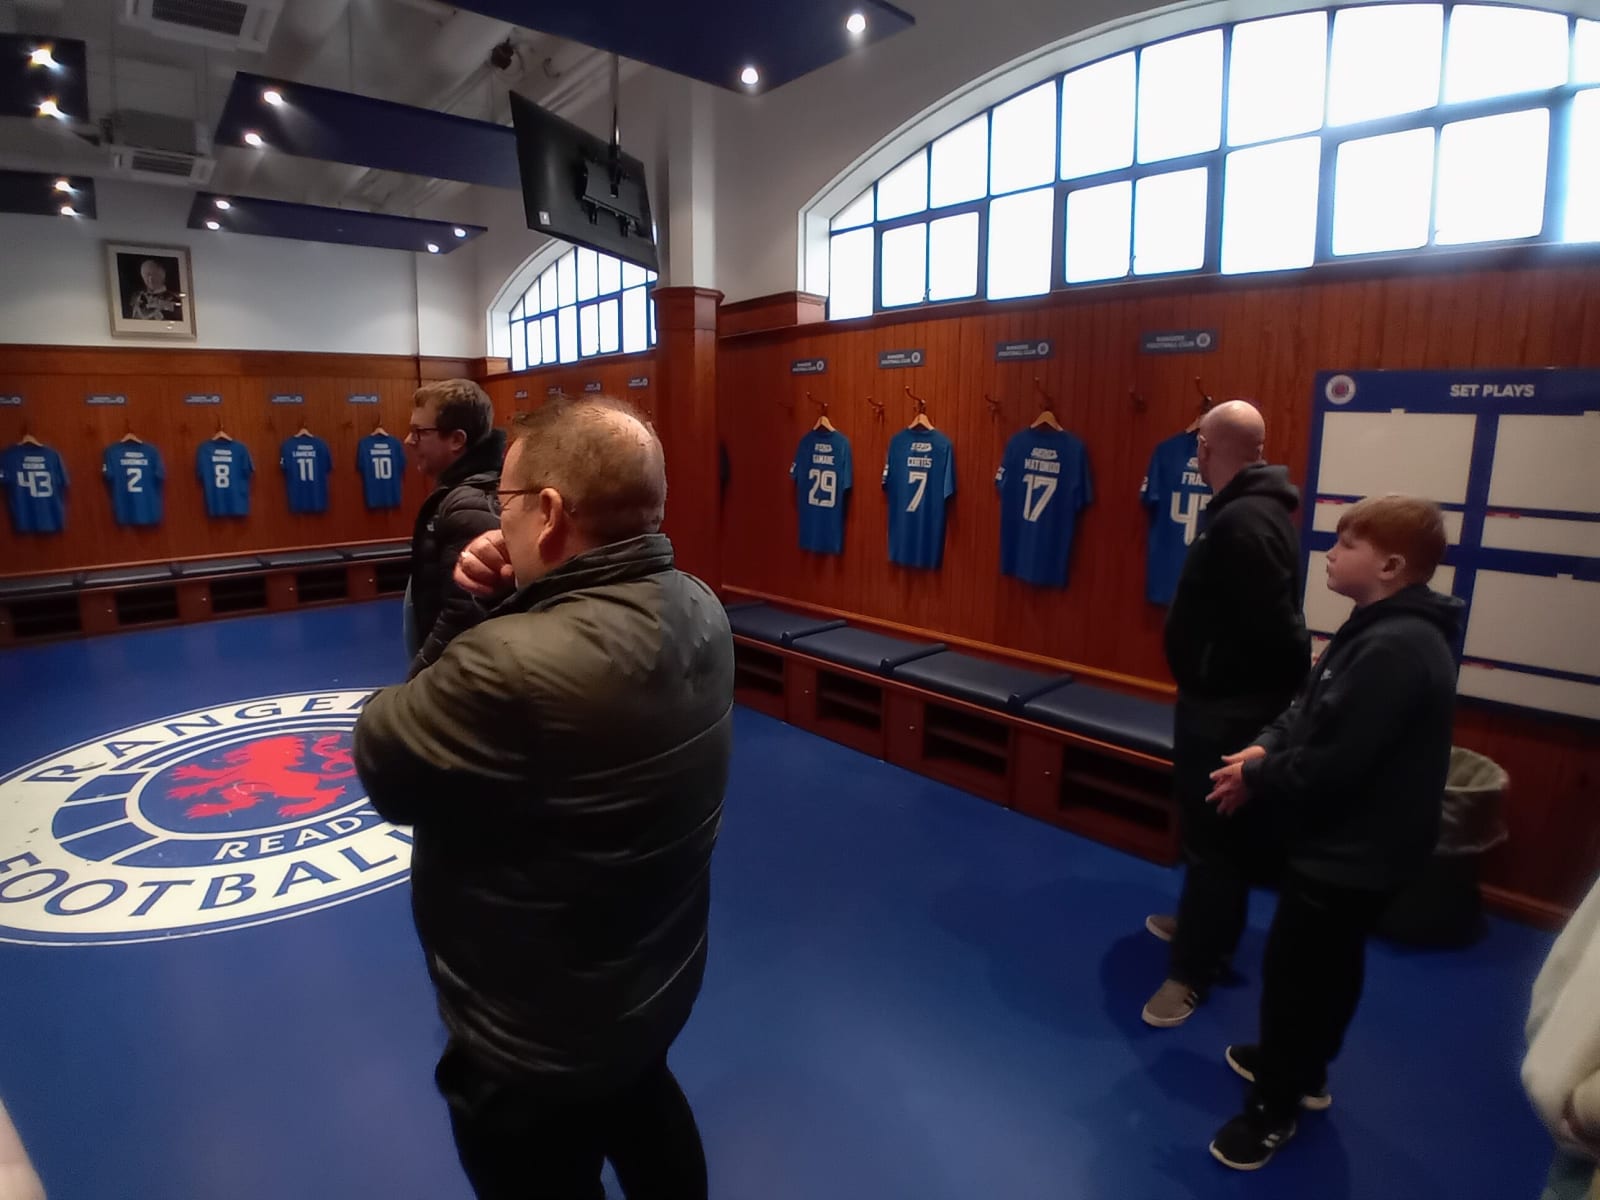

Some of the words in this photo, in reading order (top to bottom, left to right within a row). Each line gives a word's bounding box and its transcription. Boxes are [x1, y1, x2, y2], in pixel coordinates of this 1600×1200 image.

[1449, 384, 1479, 397] SET
[1482, 384, 1535, 398] PLAYS
[126, 468, 143, 493] 2
[215, 464, 230, 488] 8
[297, 458, 314, 481] 11
[372, 457, 392, 480] 10
[1181, 471, 1207, 487] FRA
[17, 471, 53, 498] 43
[808, 469, 837, 508] 29
[906, 471, 928, 512] 7
[1022, 473, 1058, 522] 17
